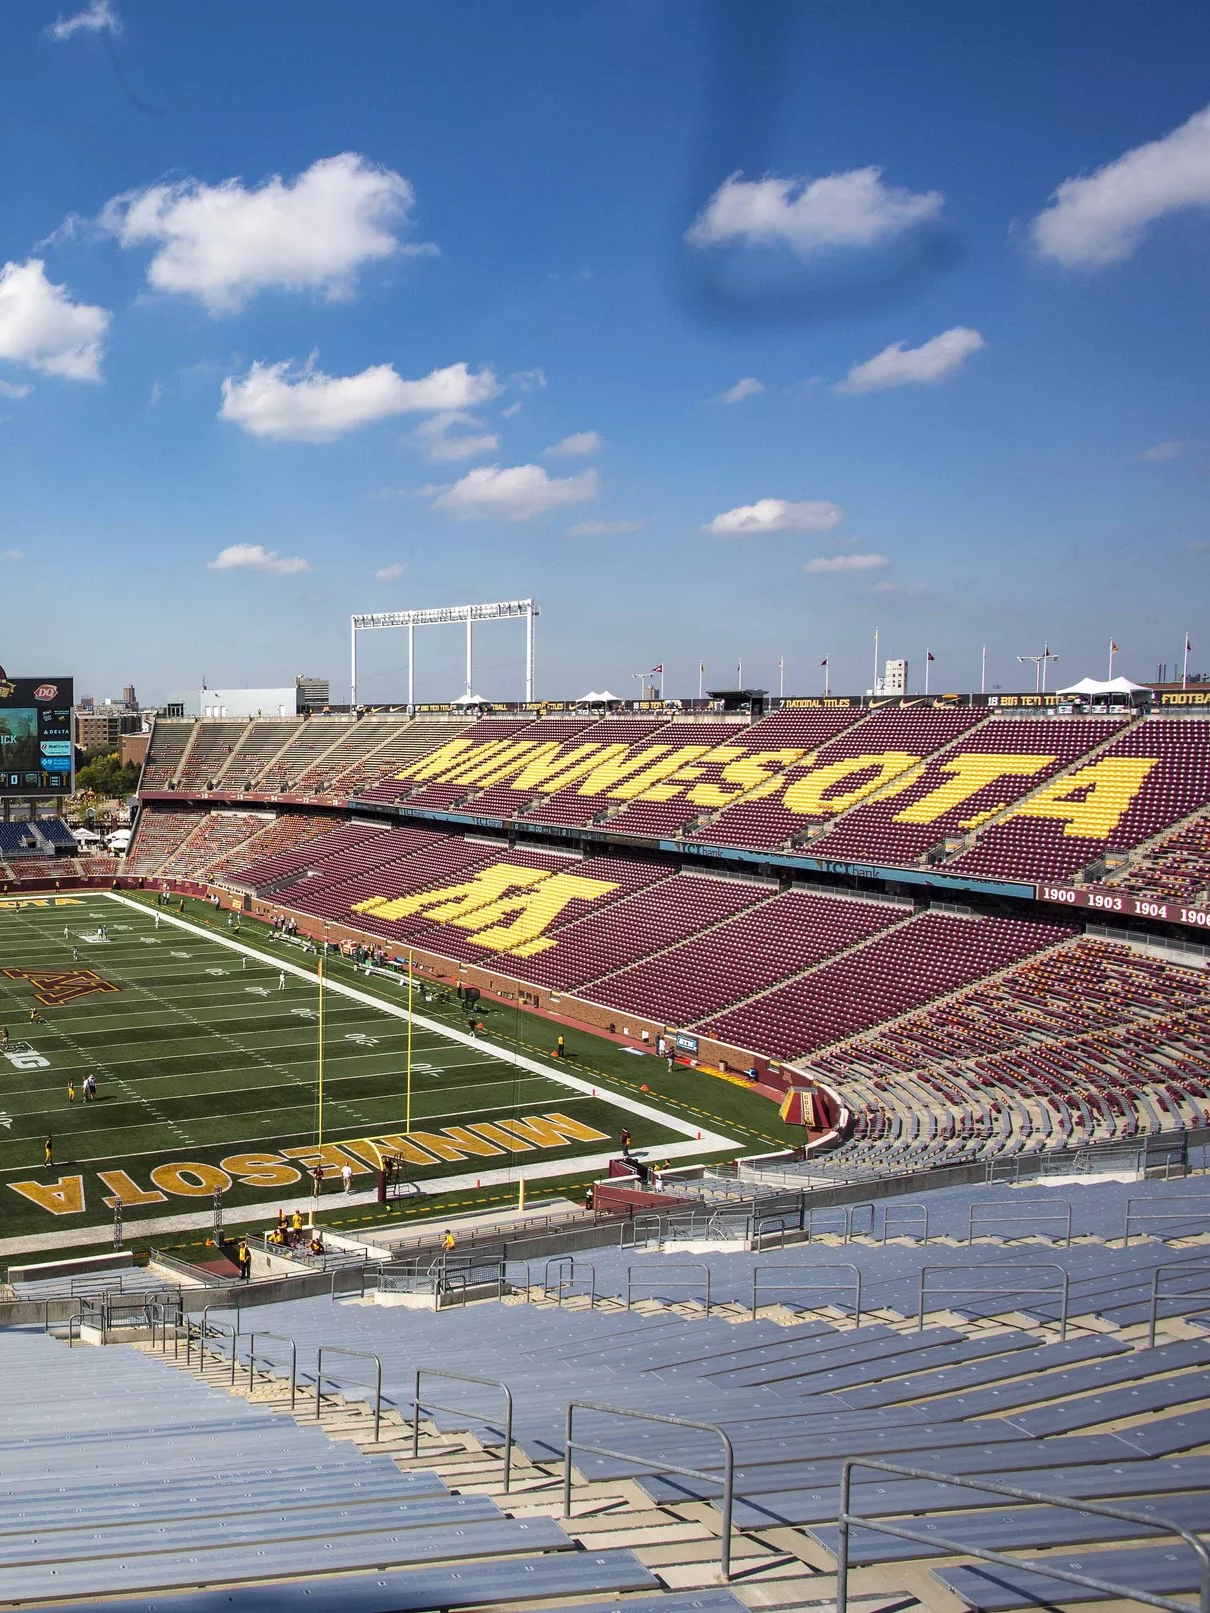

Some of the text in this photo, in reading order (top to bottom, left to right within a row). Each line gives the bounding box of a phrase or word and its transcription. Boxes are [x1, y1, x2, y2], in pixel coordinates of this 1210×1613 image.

[39, 688, 55, 697] DQ
[786, 699, 822, 708] NATIONAL
[823, 698, 850, 707] TITLES
[1000, 696, 1018, 706] BIG
[1020, 696, 1041, 706] TEN
[10, 774, 18, 785] 0
[394, 739, 1159, 838] MINNESOTA
[853, 866, 880, 879] bank
[1043, 887, 1076, 903] 1900
[1087, 894, 1122, 910] 1903
[1134, 901, 1168, 919] 1904
[6, 1112, 612, 1216] MINNESOTA
